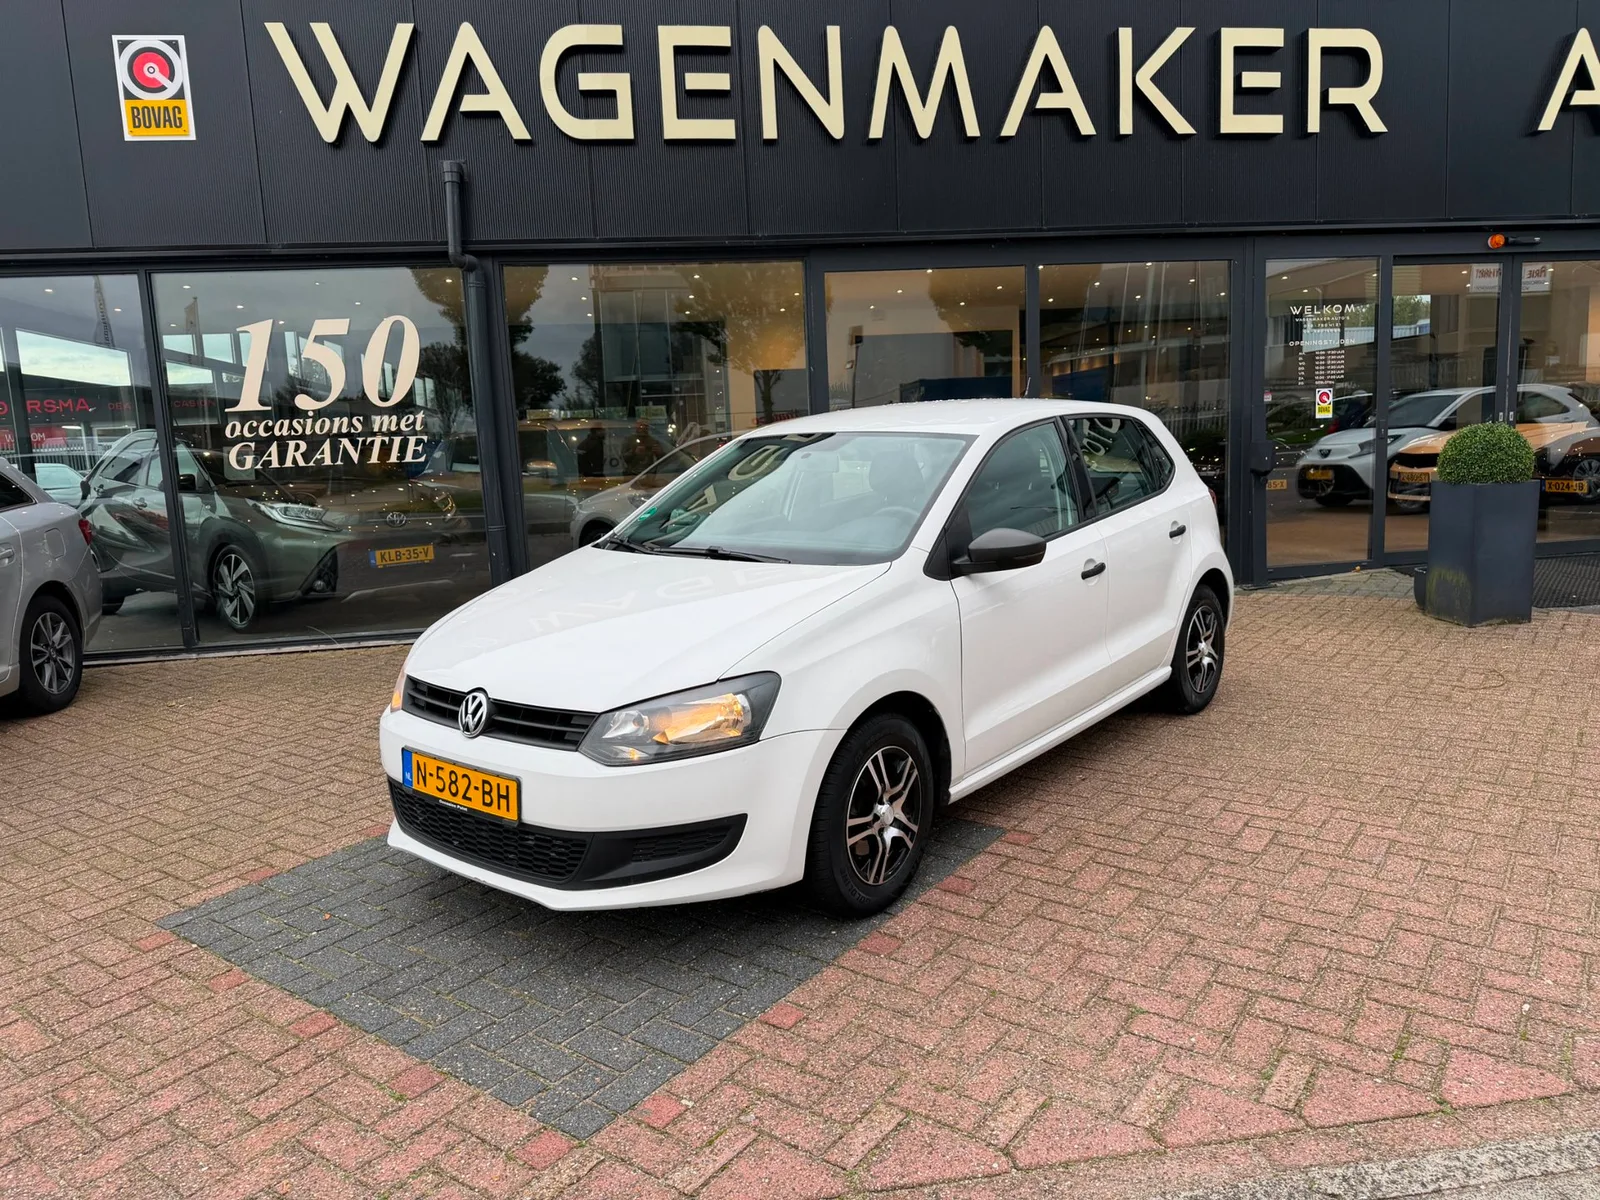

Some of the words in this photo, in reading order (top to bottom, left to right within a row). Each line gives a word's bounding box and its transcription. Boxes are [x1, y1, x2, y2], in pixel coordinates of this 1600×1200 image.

[264, 21, 1388, 143] WAGENMAKER
[130, 105, 183, 129] BOVAG
[1290, 304, 1355, 315] WELKOM
[1289, 338, 1356, 347] OPENINGSTIJDEN
[224, 315, 420, 412] 150
[172, 399, 216, 409] CASION
[225, 411, 363, 439] occasions
[373, 410, 425, 434] met
[228, 436, 428, 470] GARANTIE
[380, 547, 429, 563] KLB-35-V
[416, 759, 511, 813] N-582-BH
